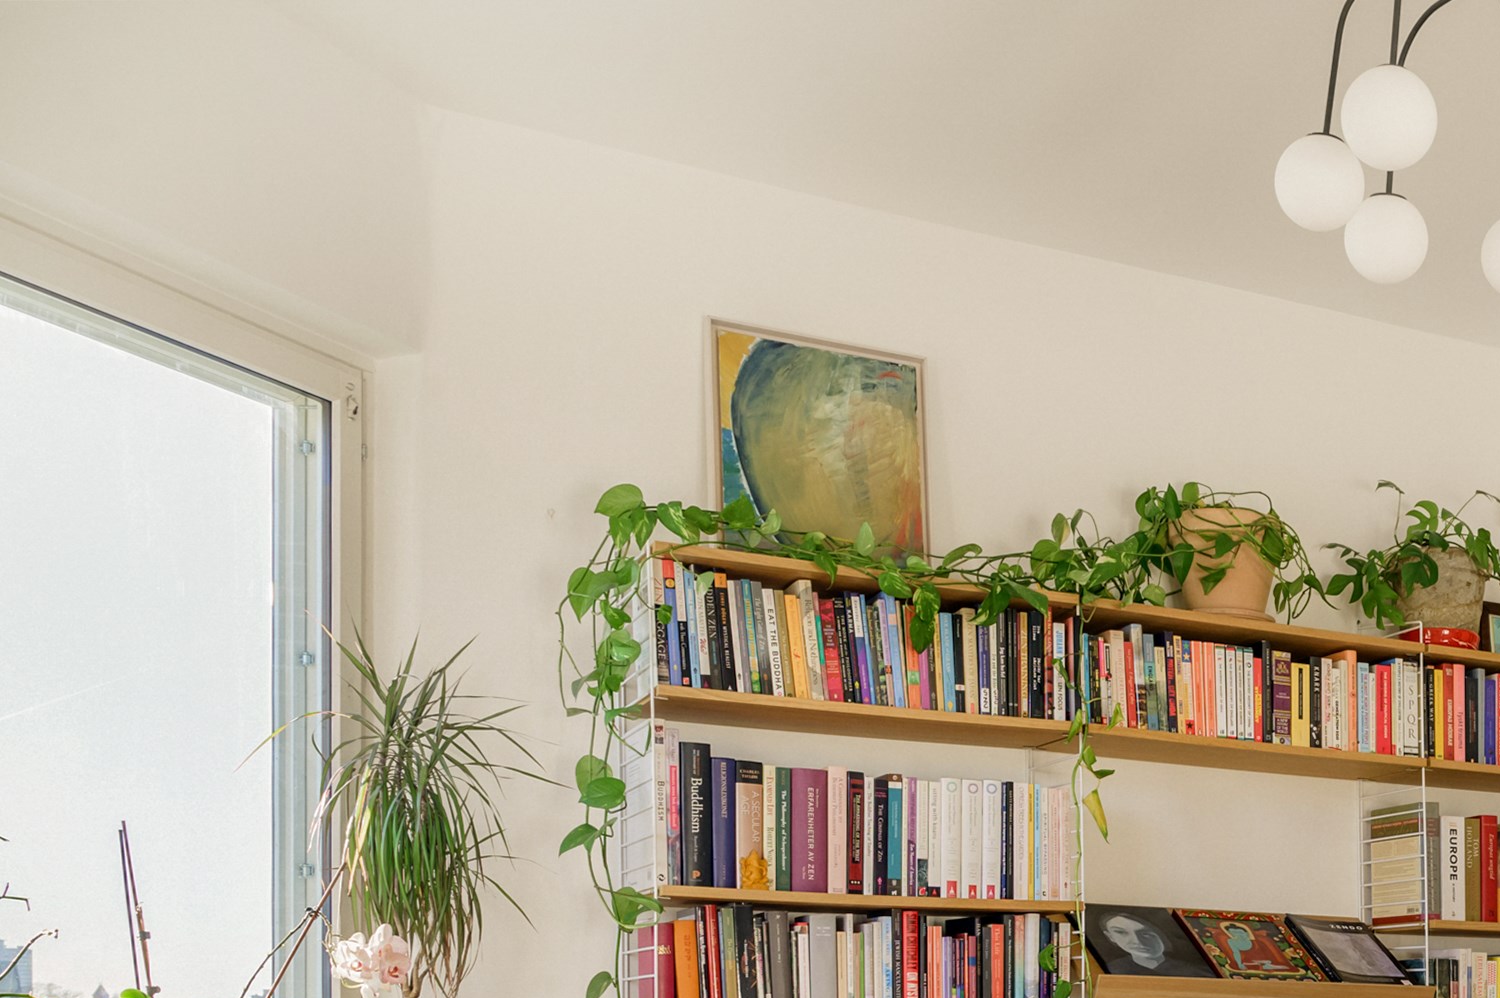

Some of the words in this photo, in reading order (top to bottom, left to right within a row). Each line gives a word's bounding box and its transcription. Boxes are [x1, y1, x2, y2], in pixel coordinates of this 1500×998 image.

[708, 619, 716, 640] ZEN
[772, 650, 782, 690] BUDDHA
[657, 780, 665, 822] BUDDHISM
[690, 778, 704, 833] Buddhism
[742, 796, 750, 815] AGE
[752, 790, 760, 799] A
[752, 800, 760, 842] SECULAR
[780, 800, 788, 828] Philosophy
[807, 787, 815, 850] ERFARENHETER
[808, 852, 814, 862] AV
[1450, 828, 1458, 880] EUROPE
[906, 972, 918, 981] ON
